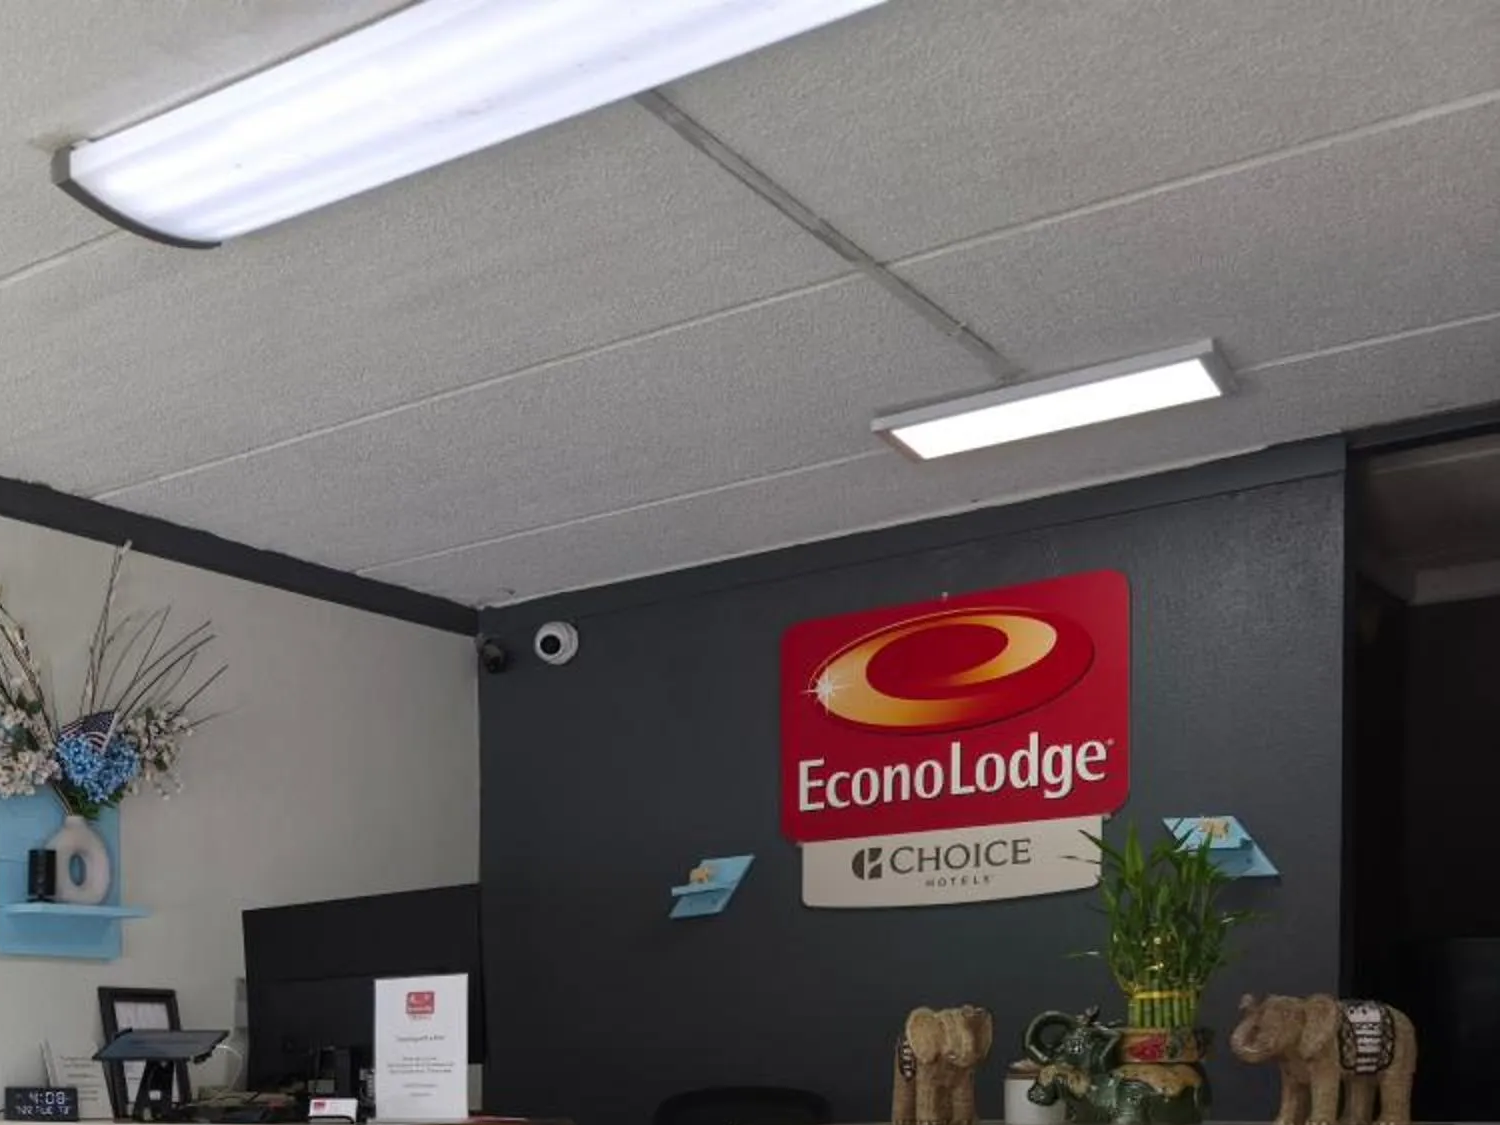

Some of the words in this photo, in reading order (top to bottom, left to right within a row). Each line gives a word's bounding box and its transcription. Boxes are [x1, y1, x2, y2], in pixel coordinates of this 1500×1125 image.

[798, 731, 1109, 813] EconoLodge
[889, 838, 1032, 874] CHOICE
[924, 874, 992, 888] HOTELS
